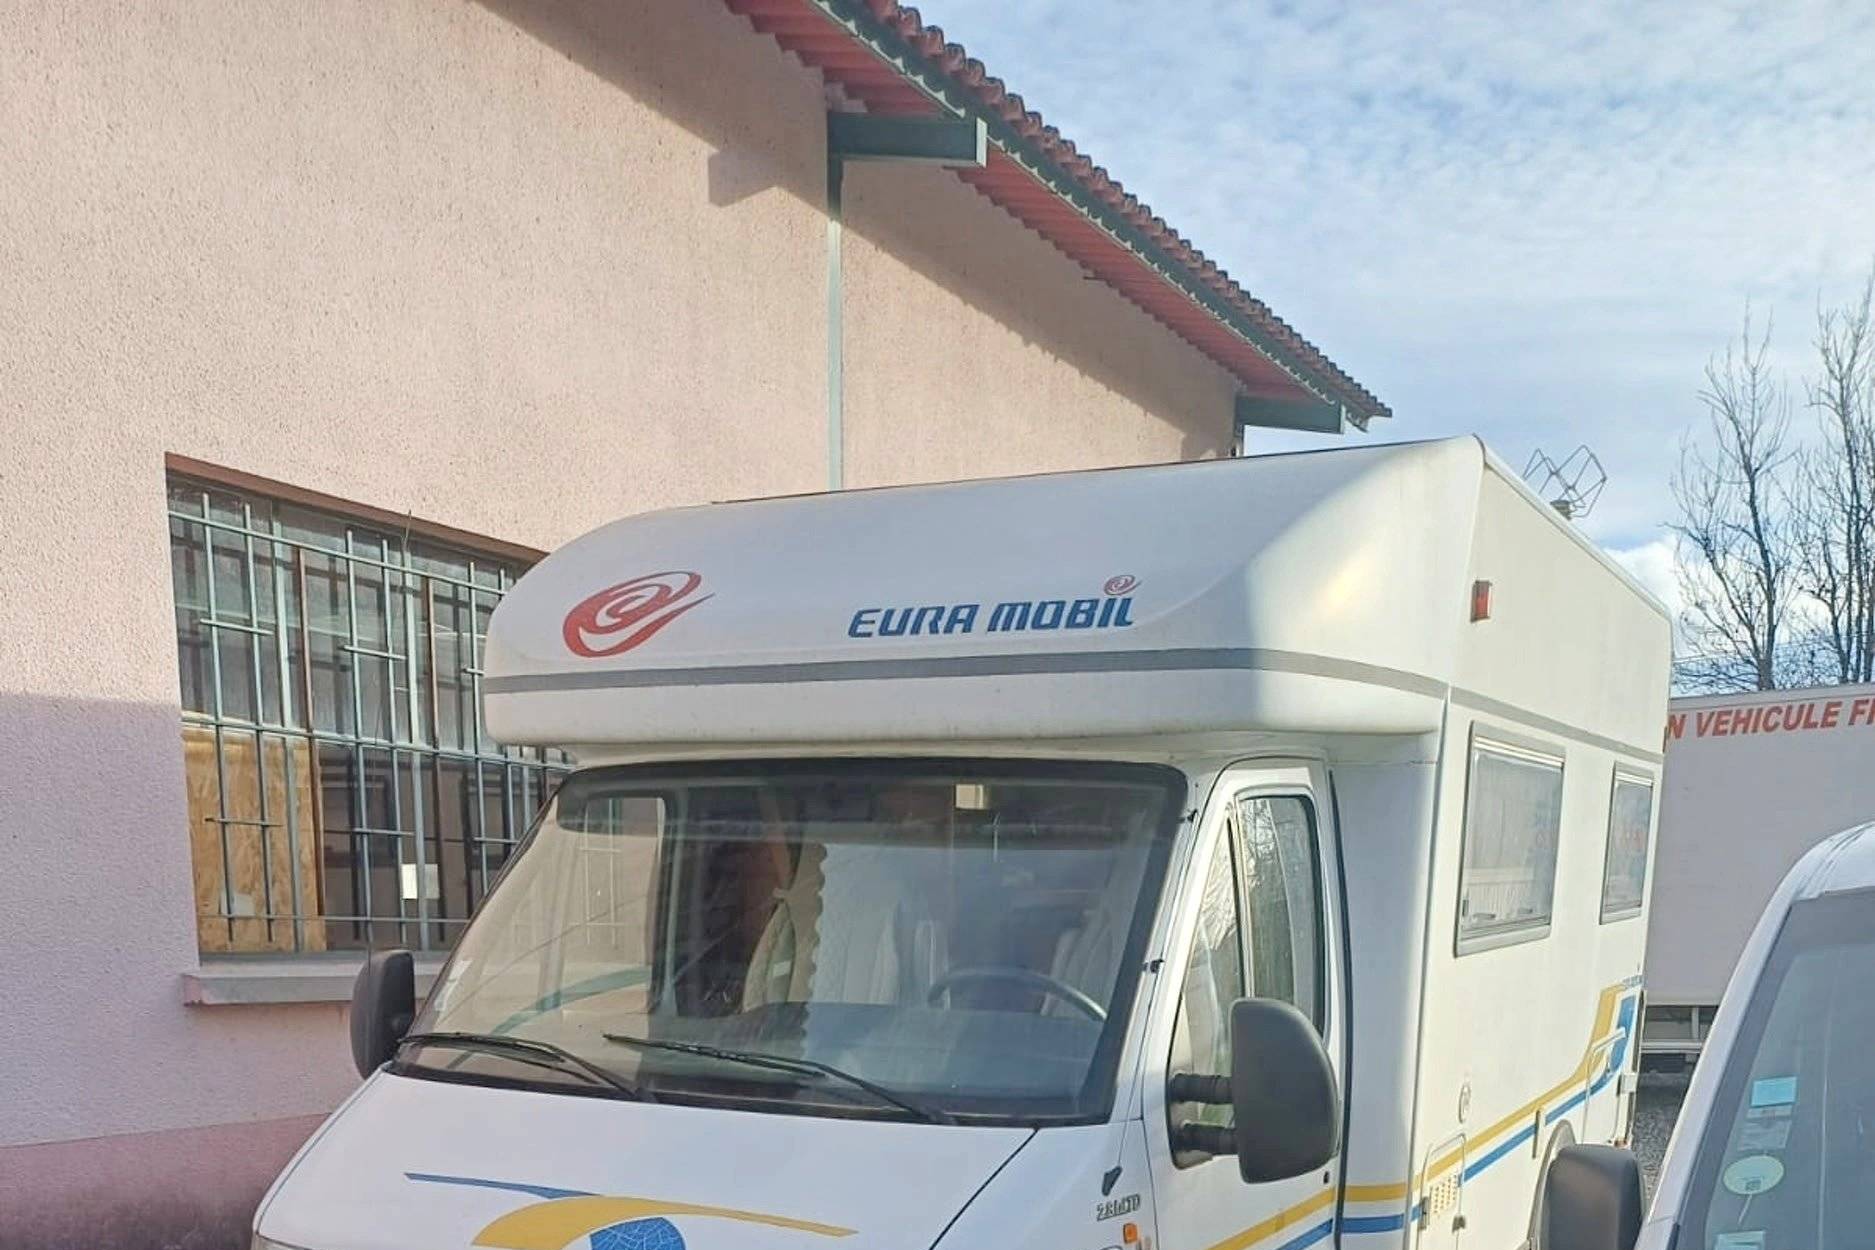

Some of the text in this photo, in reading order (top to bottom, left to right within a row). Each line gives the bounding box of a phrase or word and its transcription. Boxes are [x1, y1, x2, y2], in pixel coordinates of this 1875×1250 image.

[848, 597, 1134, 638] EURA MOBIL
[1696, 701, 1842, 737] VEHICULE
